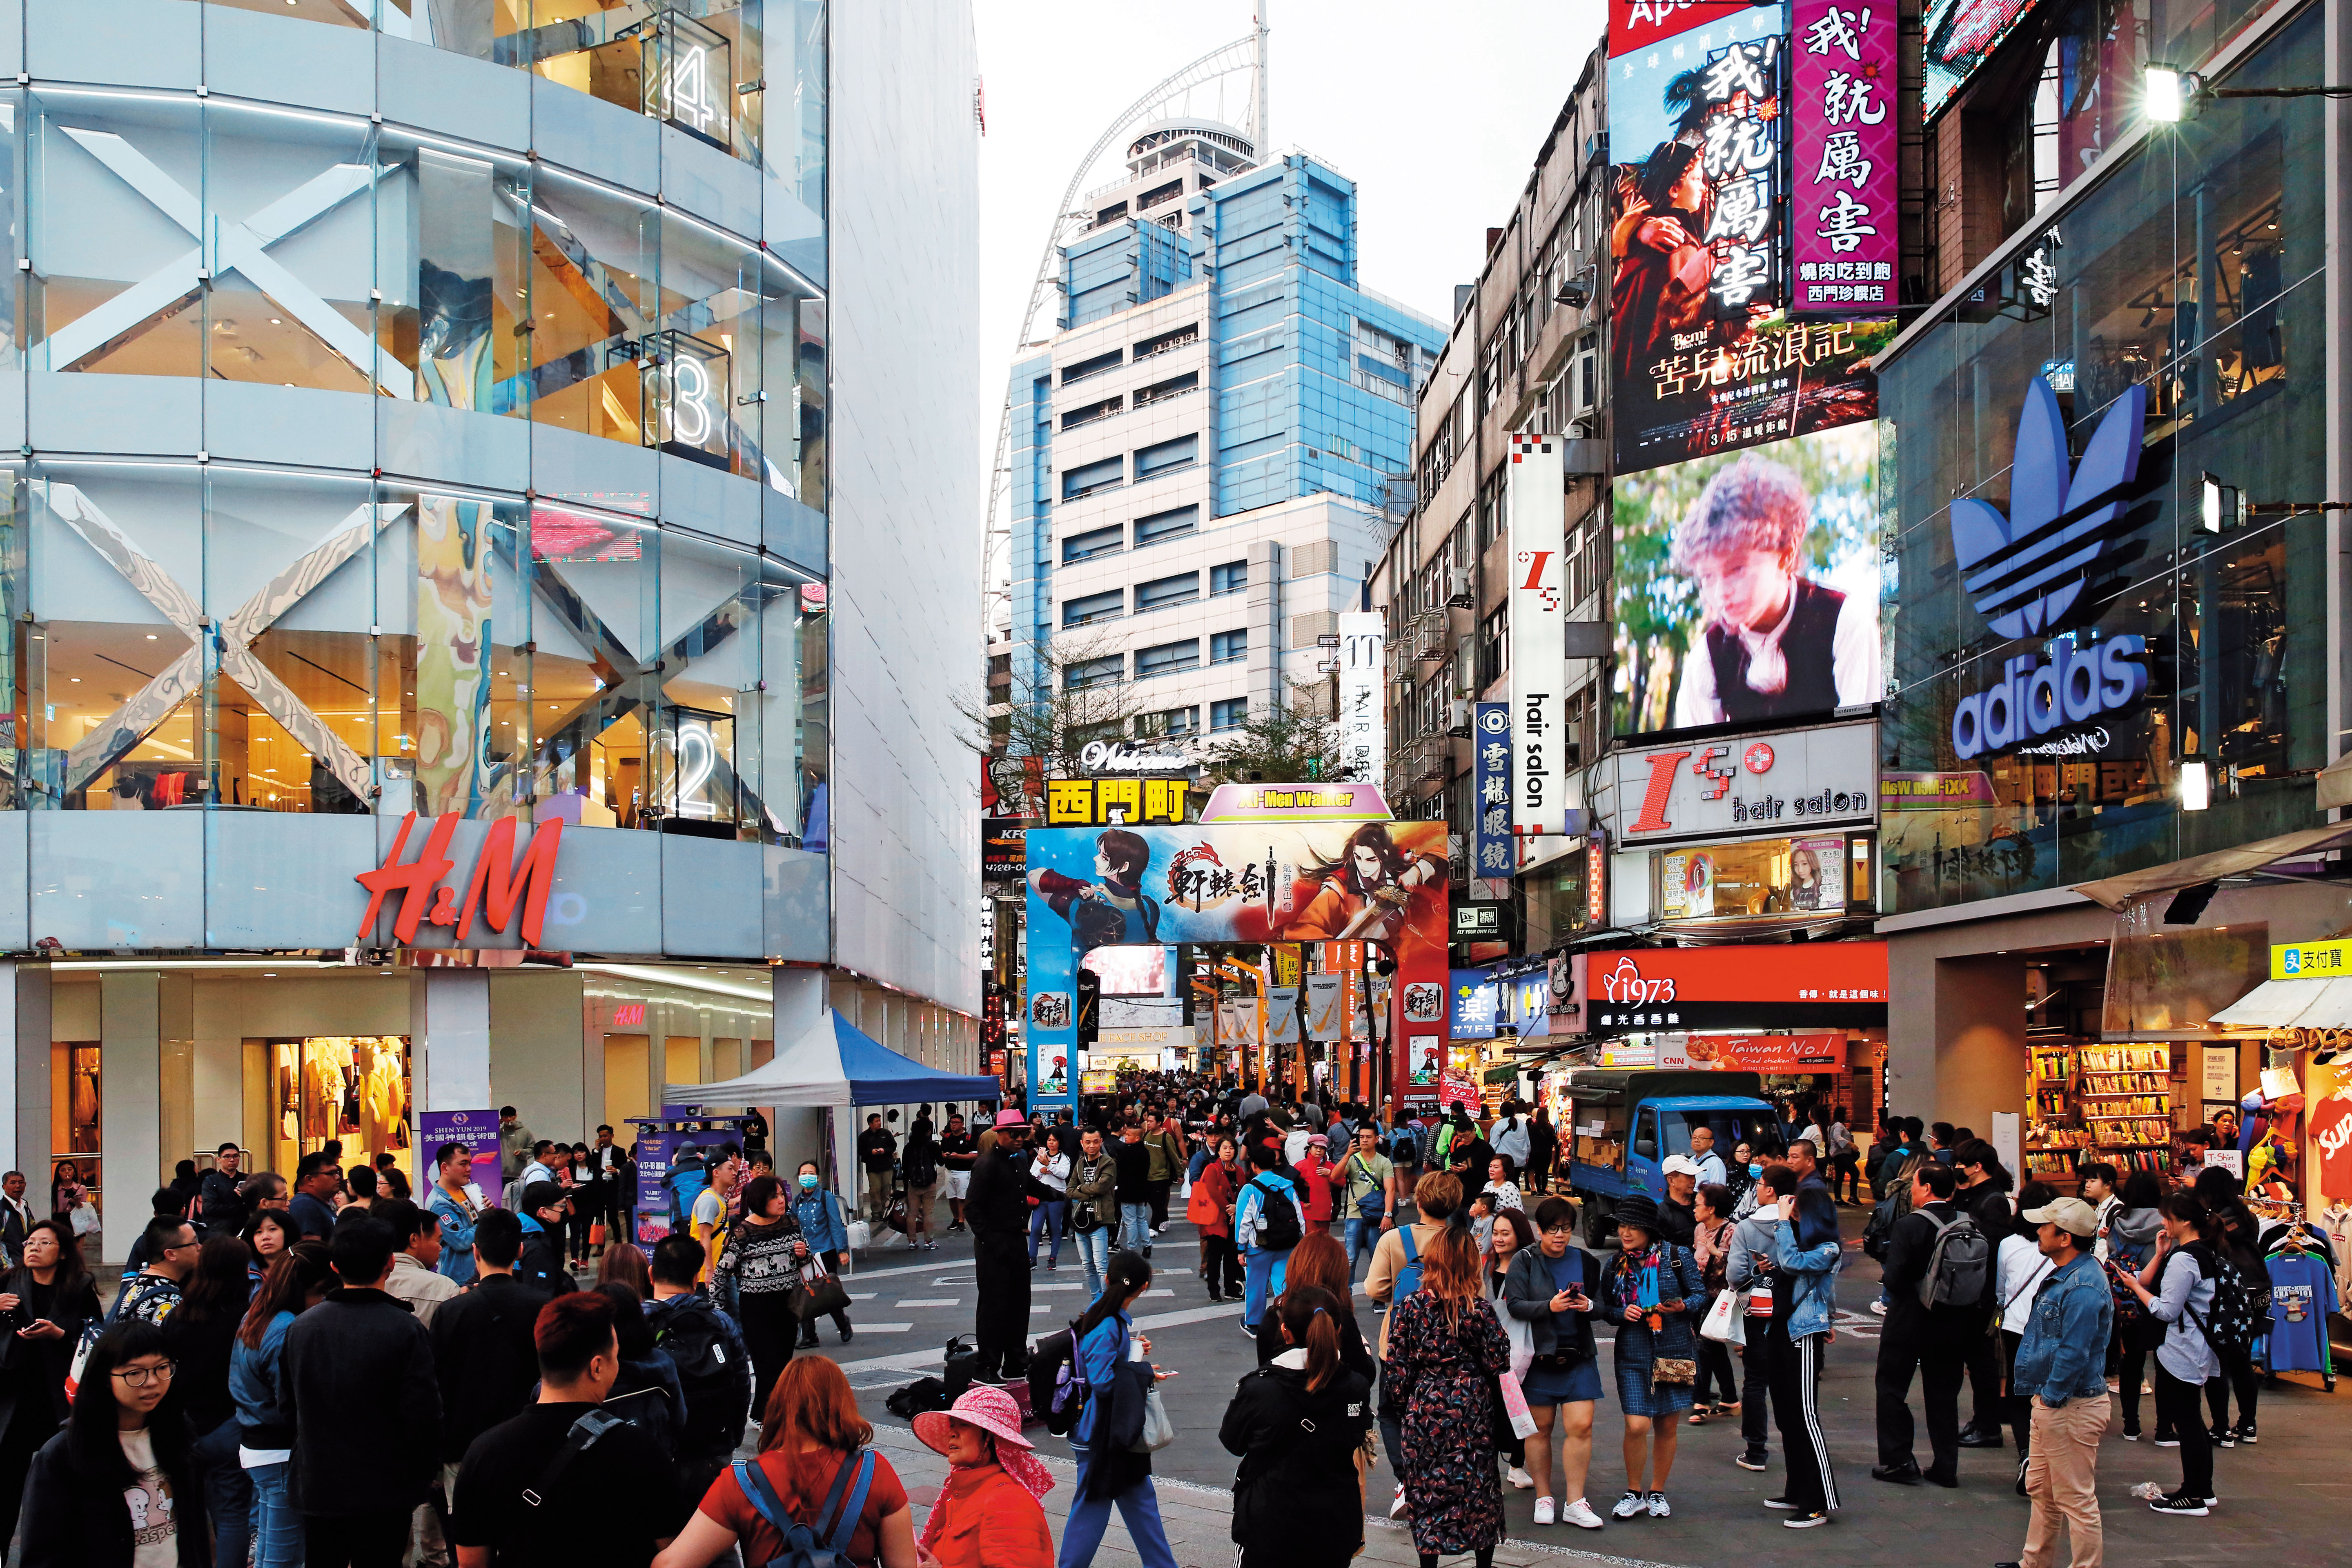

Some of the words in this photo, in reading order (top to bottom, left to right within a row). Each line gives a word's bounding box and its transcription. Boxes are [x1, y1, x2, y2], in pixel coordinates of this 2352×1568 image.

[664, 45, 713, 134] 4
[1800, 261, 1891, 281] 燒肉吃到飽
[1807, 284, 1884, 302] 西門珍饌店
[1670, 327, 1708, 347] Remi
[1648, 321, 1856, 400] 苦兒流浪記
[667, 354, 710, 445] 3
[1355, 685, 1369, 732] HAIR
[1953, 634, 2148, 760] adidas
[1526, 694, 1549, 737] hair
[1080, 739, 1189, 771] Welcome
[672, 724, 717, 816] 2
[1526, 744, 1549, 808] salon
[1048, 780, 1189, 824] 西門町
[1238, 790, 1294, 808] Xi-Men
[1296, 791, 1354, 807] Walker
[1480, 742, 1510, 870] 雪龍眼鏡
[1733, 795, 1784, 822] hair
[1794, 789, 1867, 816] salon
[355, 811, 563, 947] H&M
[1282, 863, 1292, 900] 龍舞雲山
[2303, 948, 2342, 969] 支付寶
[1621, 977, 1676, 1009] 1973
[1799, 989, 1886, 999] 香傳，就是這個味！
[614, 1004, 644, 1026] H&M
[1600, 1013, 1679, 1026] 繼光香香雞
[1109, 1033, 1137, 1042] FACE
[1138, 1031, 1168, 1042] SHOP
[1453, 1025, 1494, 1033] サツドラ
[1728, 1038, 1782, 1054] Taiwan
[1442, 1080, 1475, 1091] Taiwan
[424, 1131, 497, 1143] 美國神韻藝術團
[2207, 1153, 2234, 1162] T-Shirt
[2274, 1290, 2313, 1298] CHAPION
[135, 1522, 178, 1547] asper
